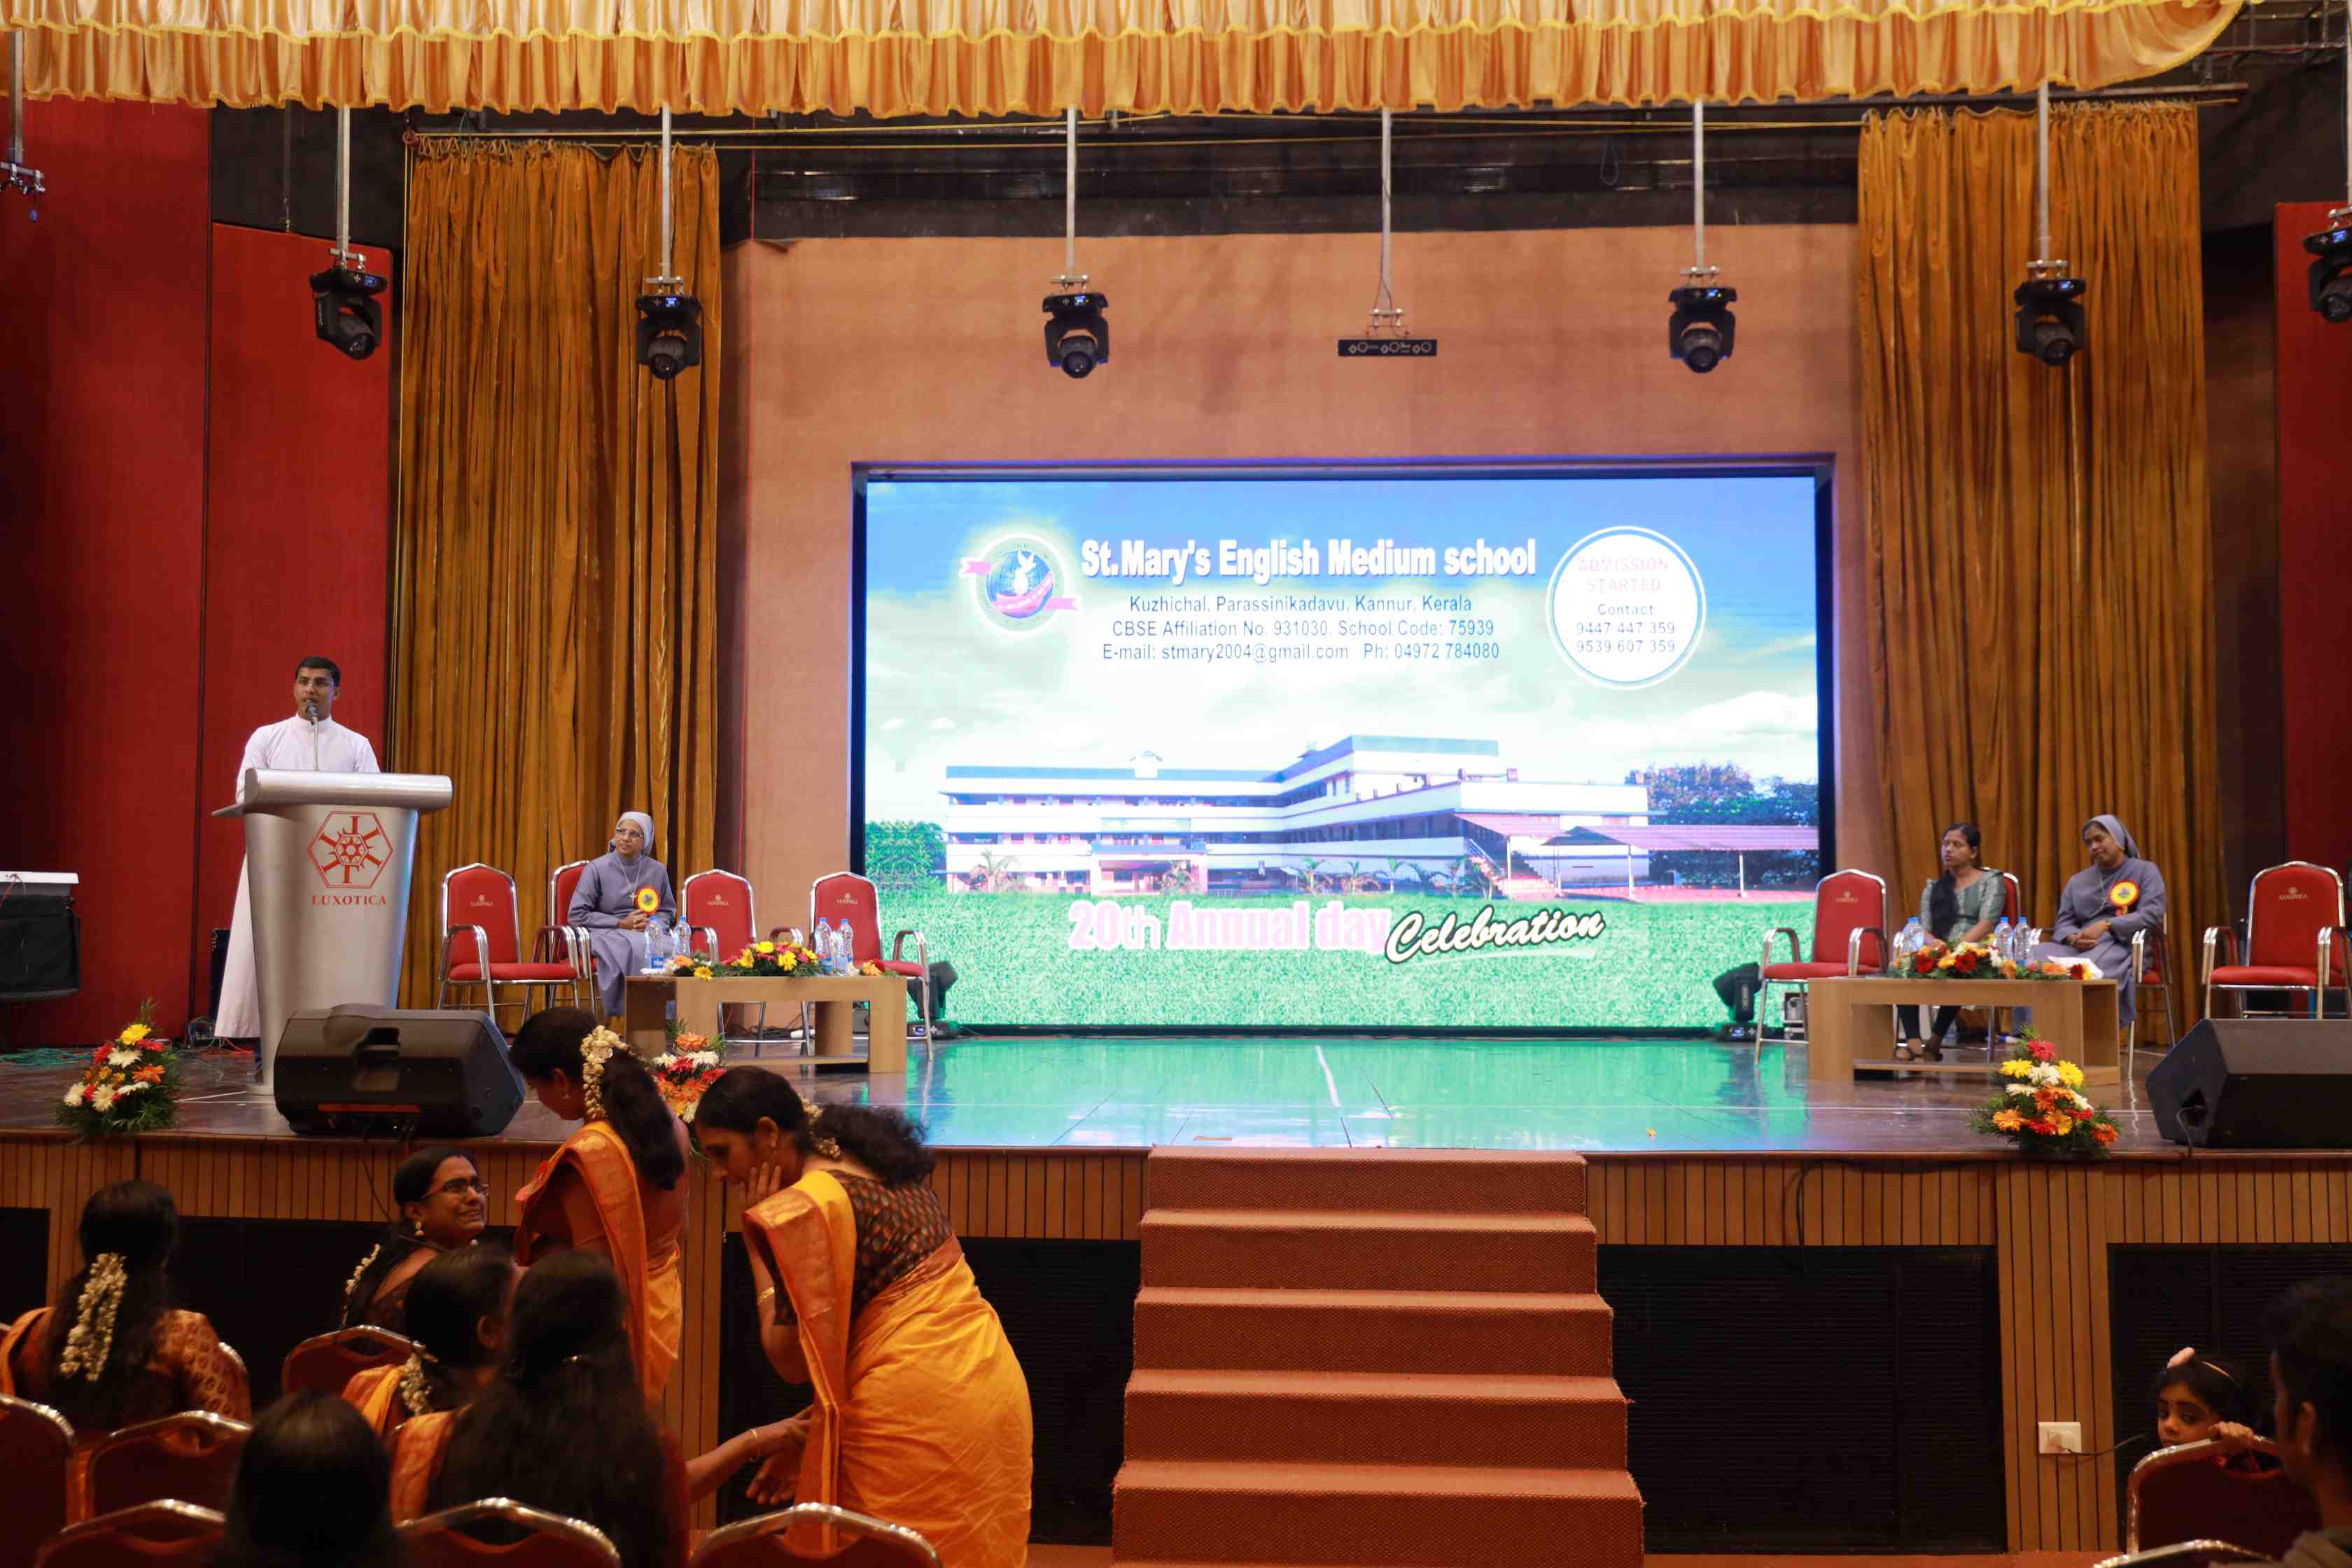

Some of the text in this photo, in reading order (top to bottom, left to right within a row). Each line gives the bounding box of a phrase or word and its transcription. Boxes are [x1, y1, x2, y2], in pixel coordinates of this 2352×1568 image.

[1081, 538, 1211, 585] St.Mary's
[1219, 538, 1320, 586] English
[1328, 538, 1436, 576] Medium
[1443, 538, 1536, 575] school
[1578, 556, 1670, 573] ADMISSION
[1586, 578, 1662, 592] STARTED
[1422, 594, 1471, 611] Kerala
[1597, 603, 1654, 616] Contact
[1112, 620, 1157, 636] CBSE
[1163, 620, 1237, 636] Affiliation
[1338, 620, 1392, 636] School
[1398, 620, 1443, 636] Code:
[1448, 619, 1494, 636] 75939
[1576, 622, 1675, 635] 9447 447 359
[1103, 643, 1499, 663] E-mail: stmary2004@gmail.com Ph: 04972 784080
[1576, 639, 1675, 653] 9539 607 359
[312, 895, 387, 906] LUXOTICA
[1068, 899, 1606, 964] 20th Annual day Celebration
